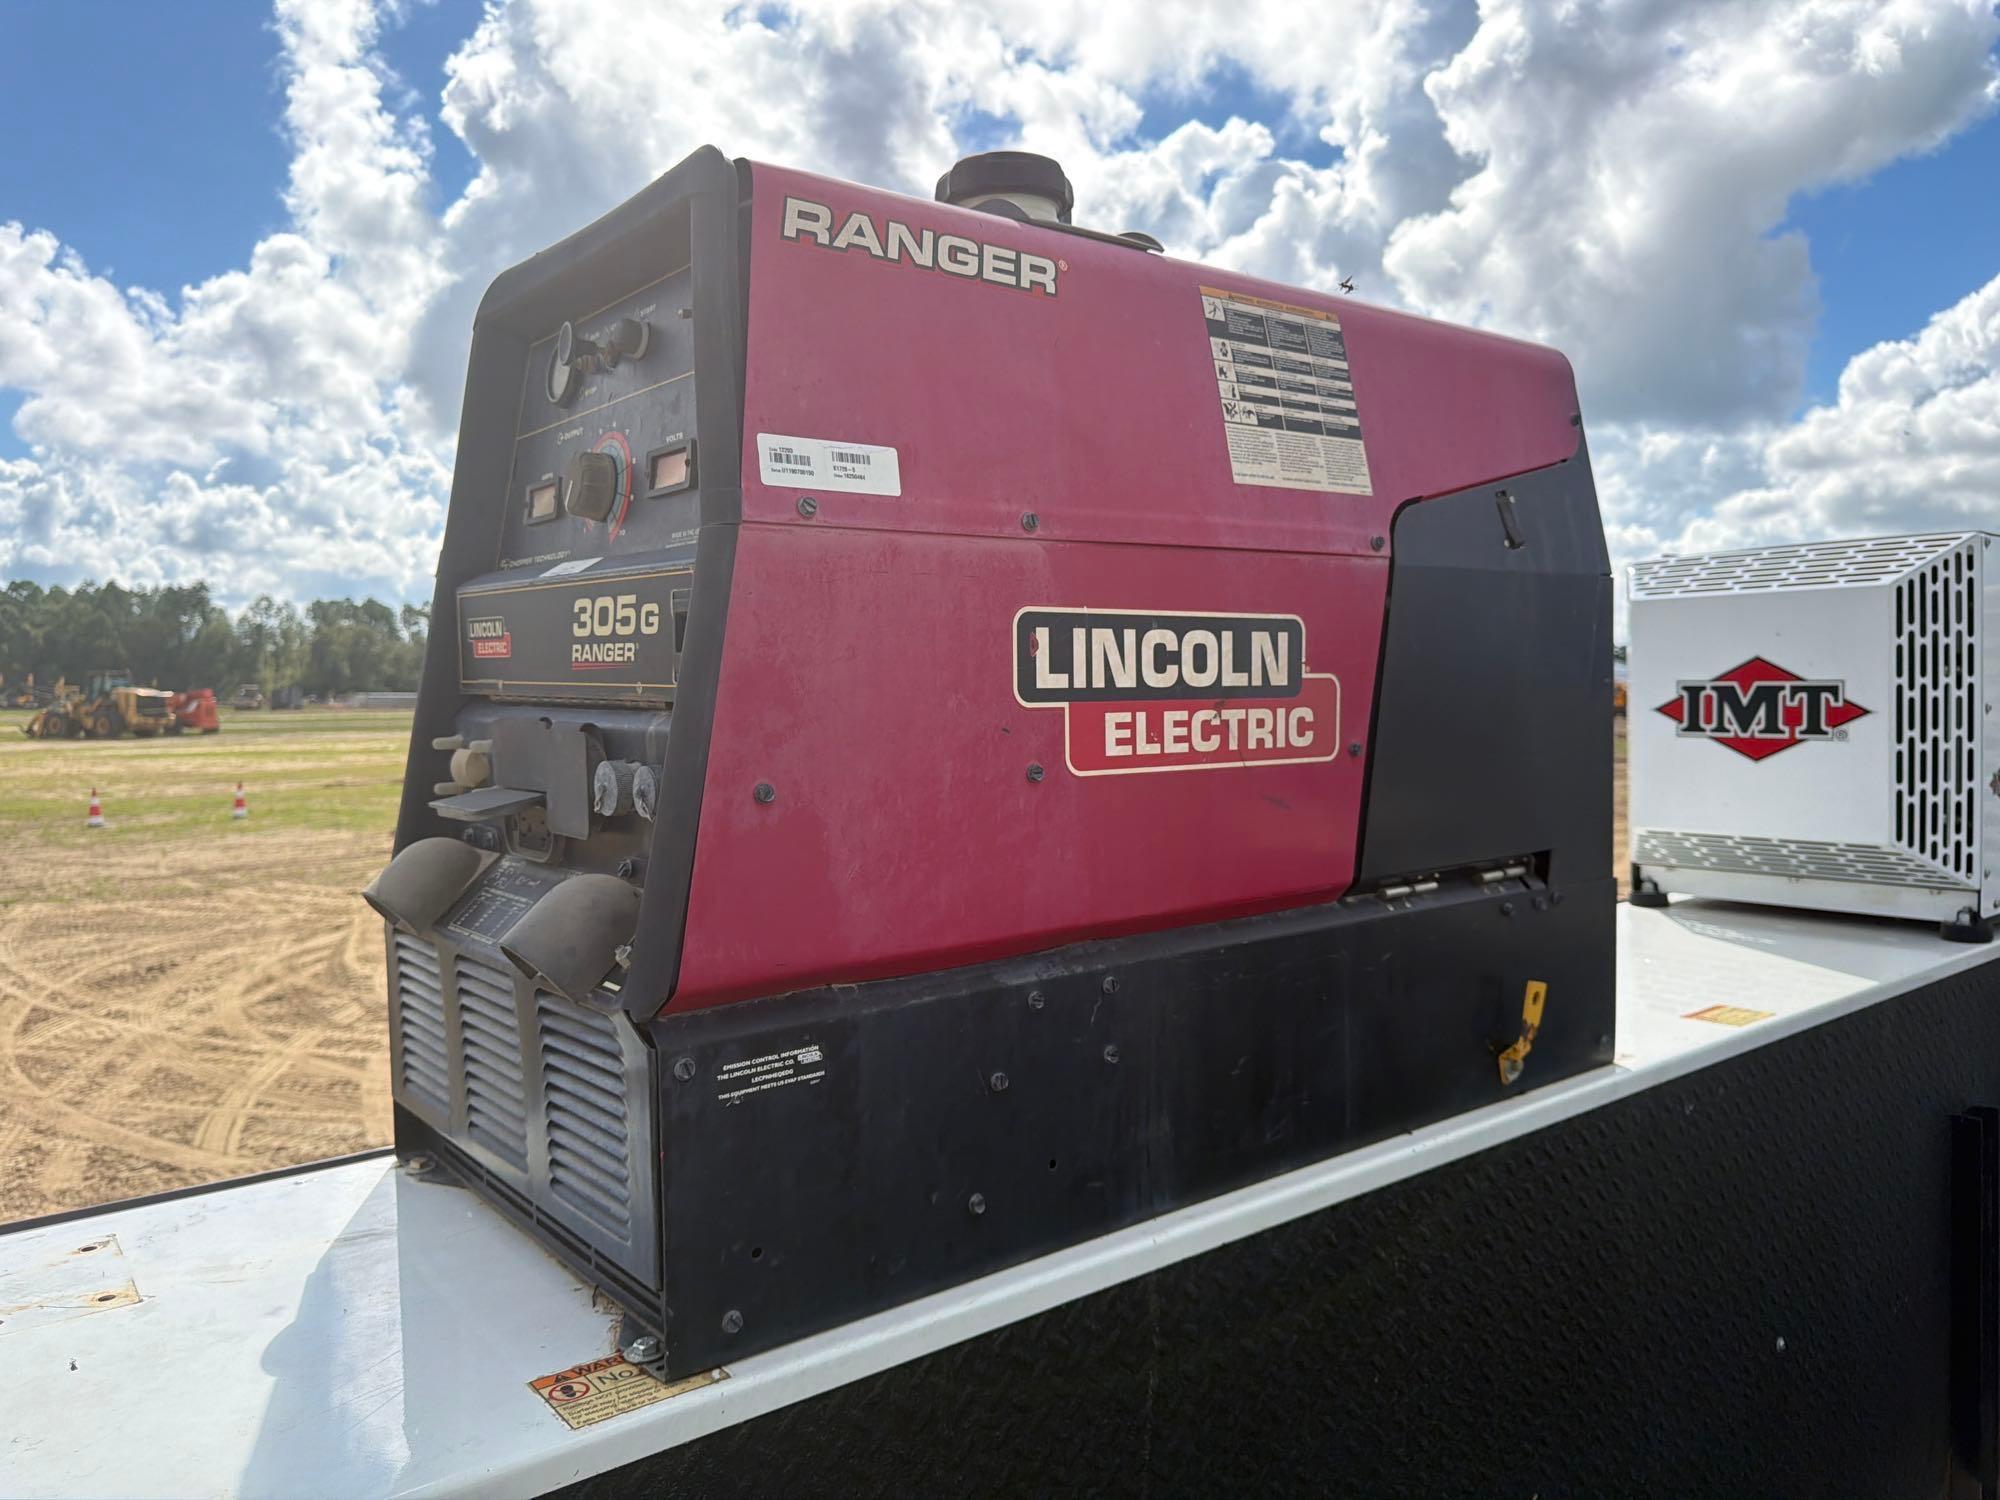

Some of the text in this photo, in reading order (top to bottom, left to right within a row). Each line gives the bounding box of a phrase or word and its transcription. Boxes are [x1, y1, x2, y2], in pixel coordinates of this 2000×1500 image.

[782, 196, 1057, 295] RANGER
[470, 621, 502, 638] LINCOLN
[477, 641, 507, 654] ELECTRIC
[572, 642, 635, 662] RANGER
[1035, 627, 1289, 689] LINCOLN
[1681, 684, 1840, 736] IMT
[1105, 706, 1314, 757] ELECTRIC
[723, 1045, 819, 1071] EMISSION CONTROL INFORMATION
[729, 1067, 756, 1078] LINCOLN
[757, 1062, 784, 1073] ELECTRIC
[730, 1086, 760, 1098] EQUIPMENT
[760, 1081, 777, 1091] MEETS
[797, 1070, 825, 1081] STANDARDS
